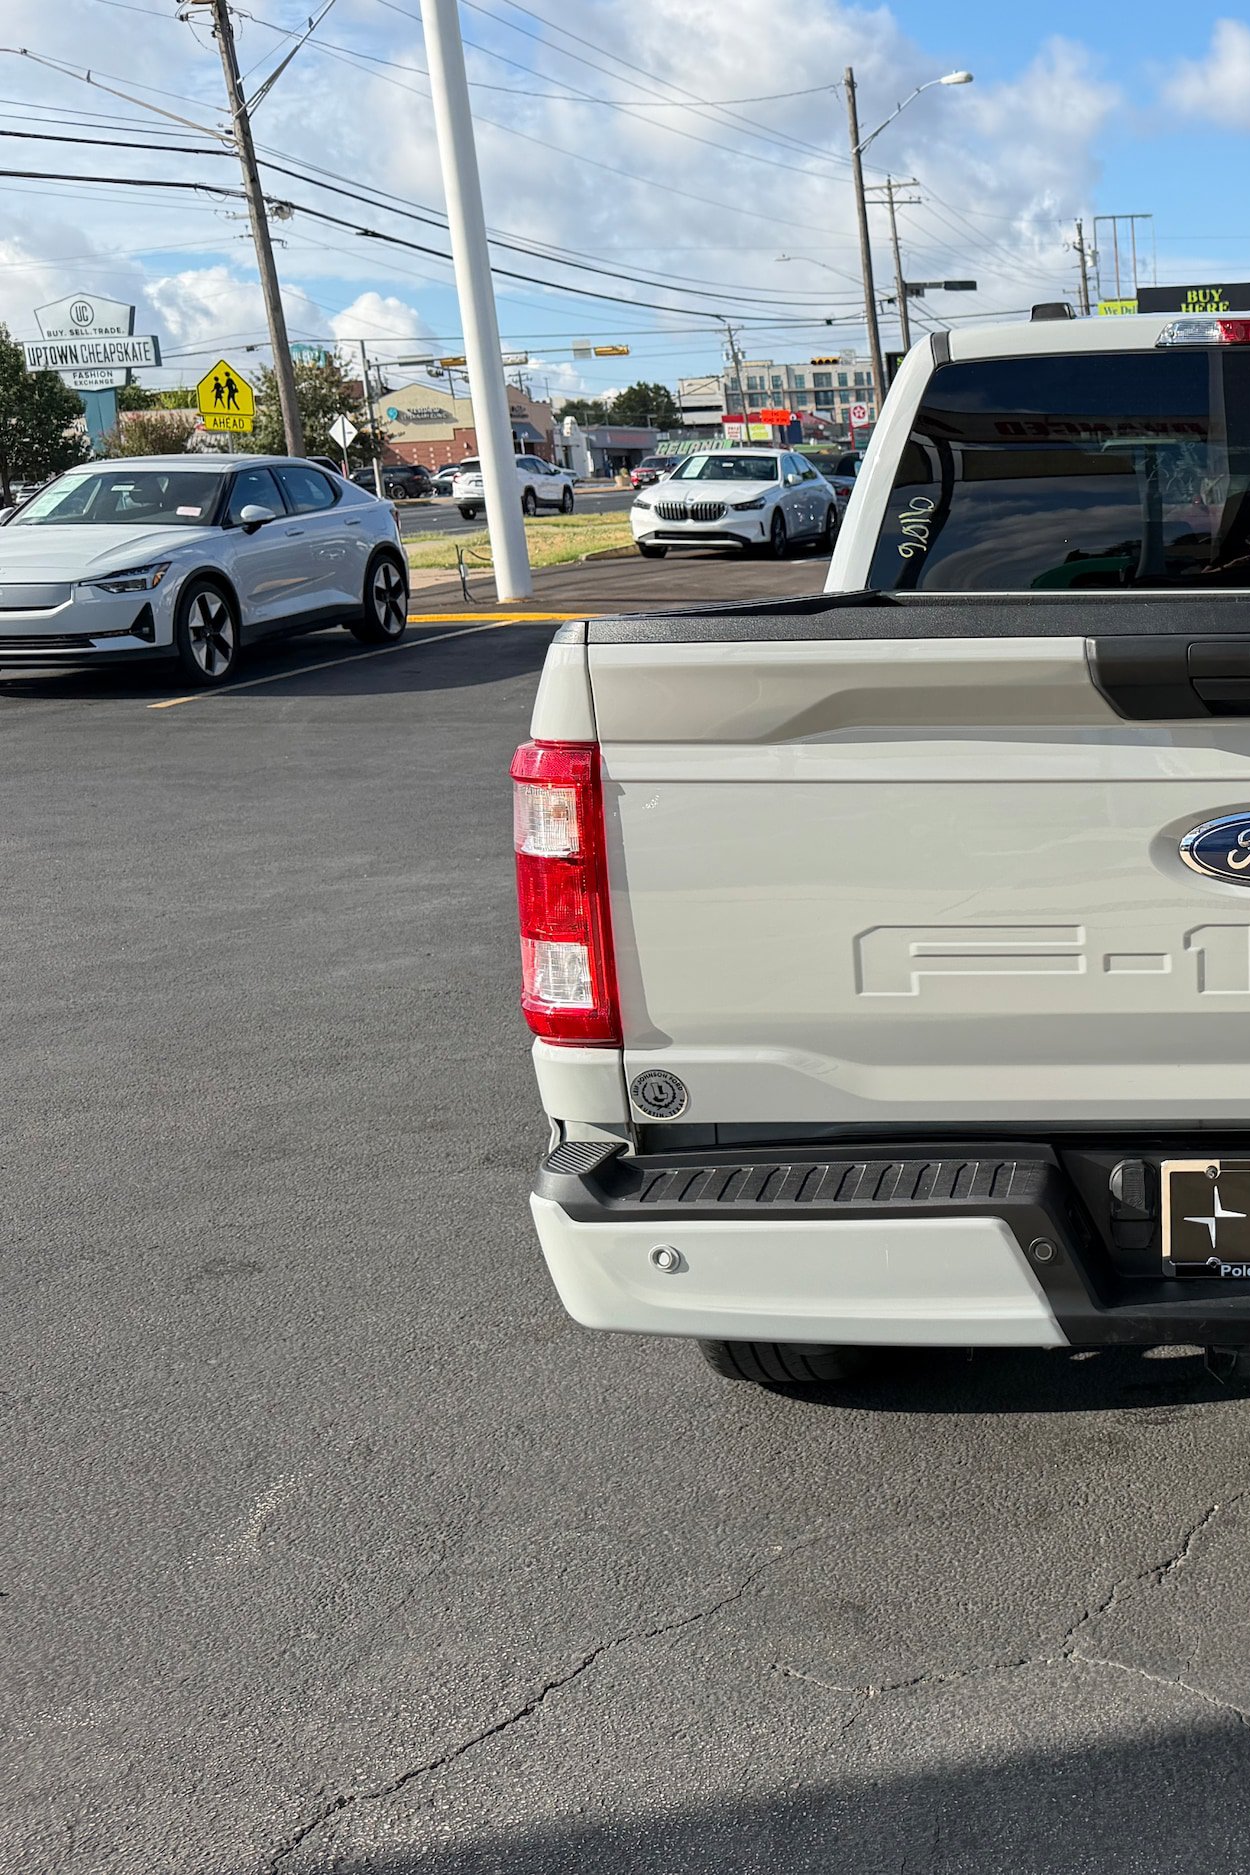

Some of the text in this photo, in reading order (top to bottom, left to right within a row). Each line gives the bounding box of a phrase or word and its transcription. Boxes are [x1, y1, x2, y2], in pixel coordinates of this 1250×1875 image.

[1187, 289, 1223, 303] BUY
[75, 305, 89, 322] UC
[46, 326, 125, 338] BUY. SELL. TRADE.
[27, 341, 151, 366] UPTOWN CHEAPSKATE
[72, 371, 113, 380] FASHION
[74, 379, 114, 387] EXCHANGE
[212, 417, 245, 429] AHEAD
[669, 1076, 683, 1091] FORD
